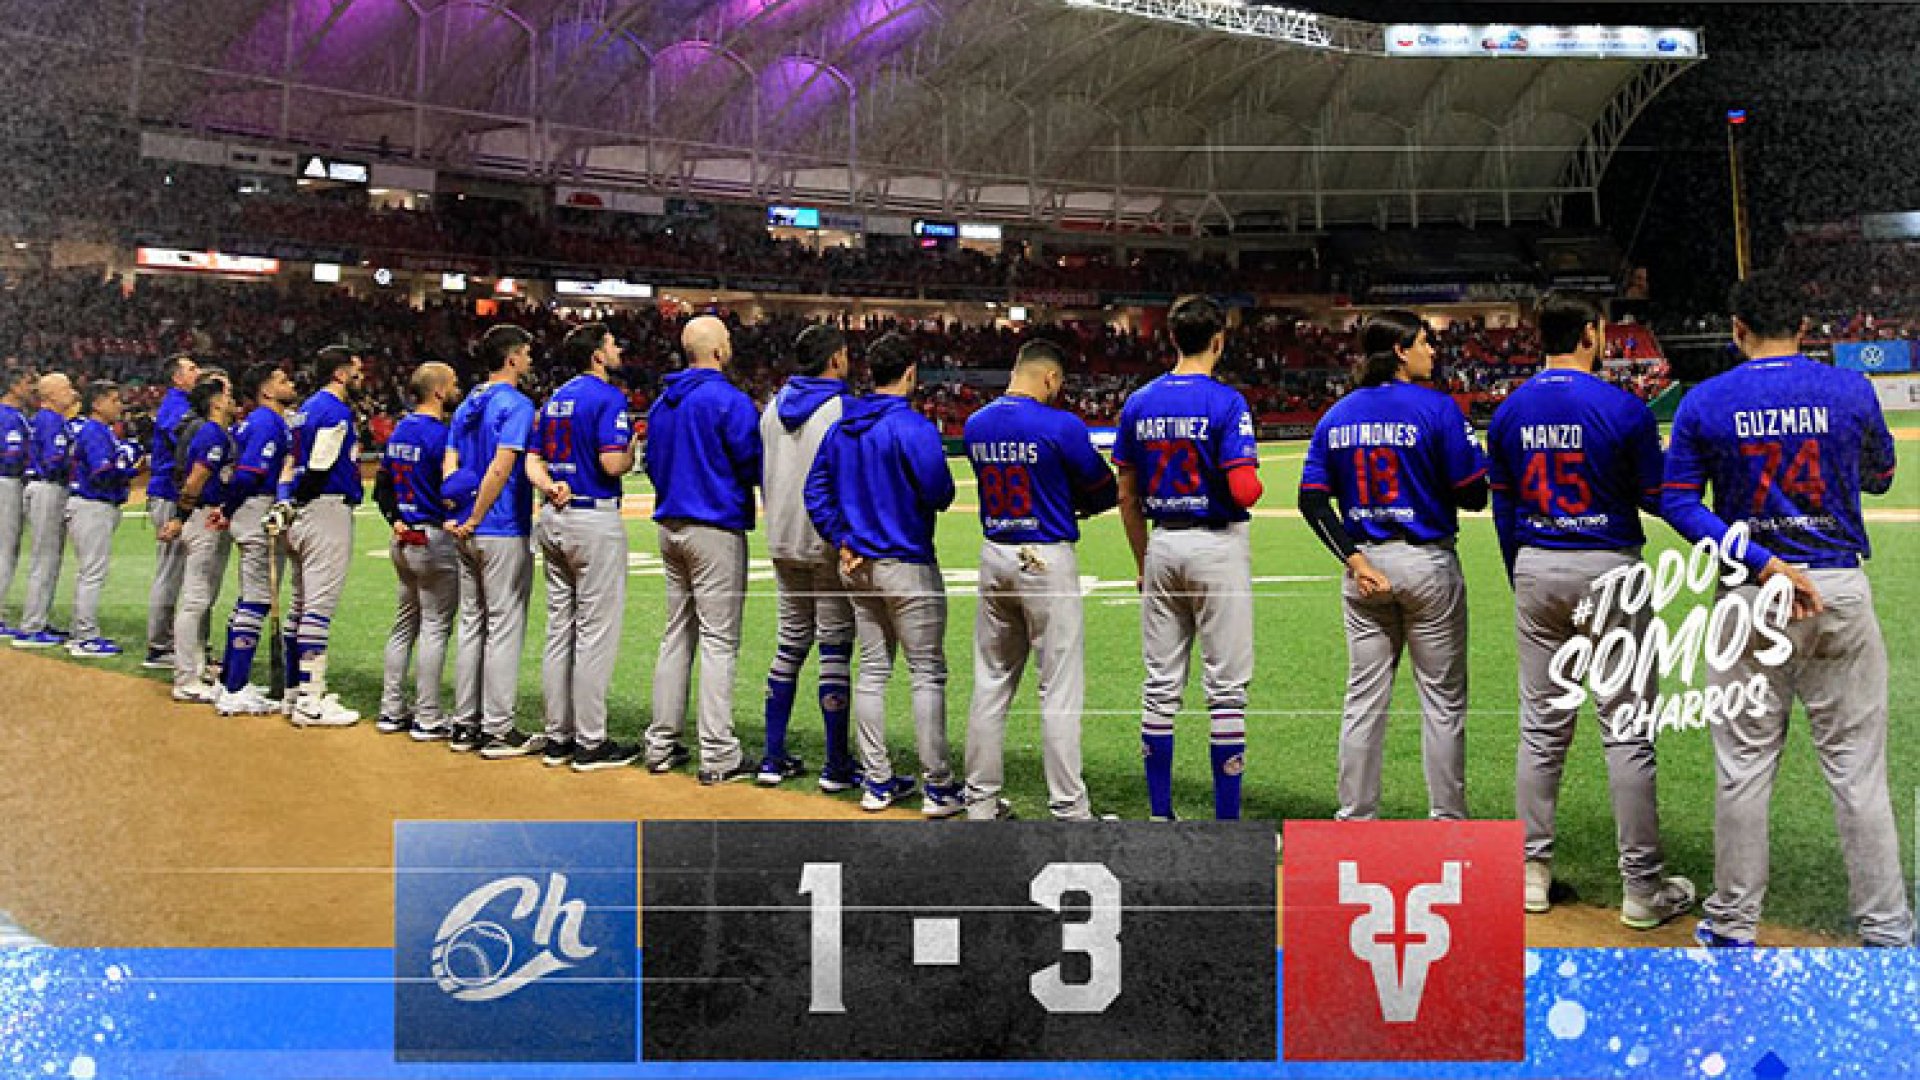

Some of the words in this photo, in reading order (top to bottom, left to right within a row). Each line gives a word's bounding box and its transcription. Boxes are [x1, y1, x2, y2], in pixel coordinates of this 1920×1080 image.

[1136, 416, 1209, 440] MARTINEZ
[1520, 424, 1583, 449] MANZO
[1734, 406, 1829, 438] GUZMAN
[971, 442, 1038, 464] VILLEGAS
[1144, 439, 1201, 495] 73
[1353, 447, 1400, 505] 18
[1740, 439, 1827, 514] 74
[980, 464, 1032, 518] 88
[1520, 452, 1593, 514] 45
